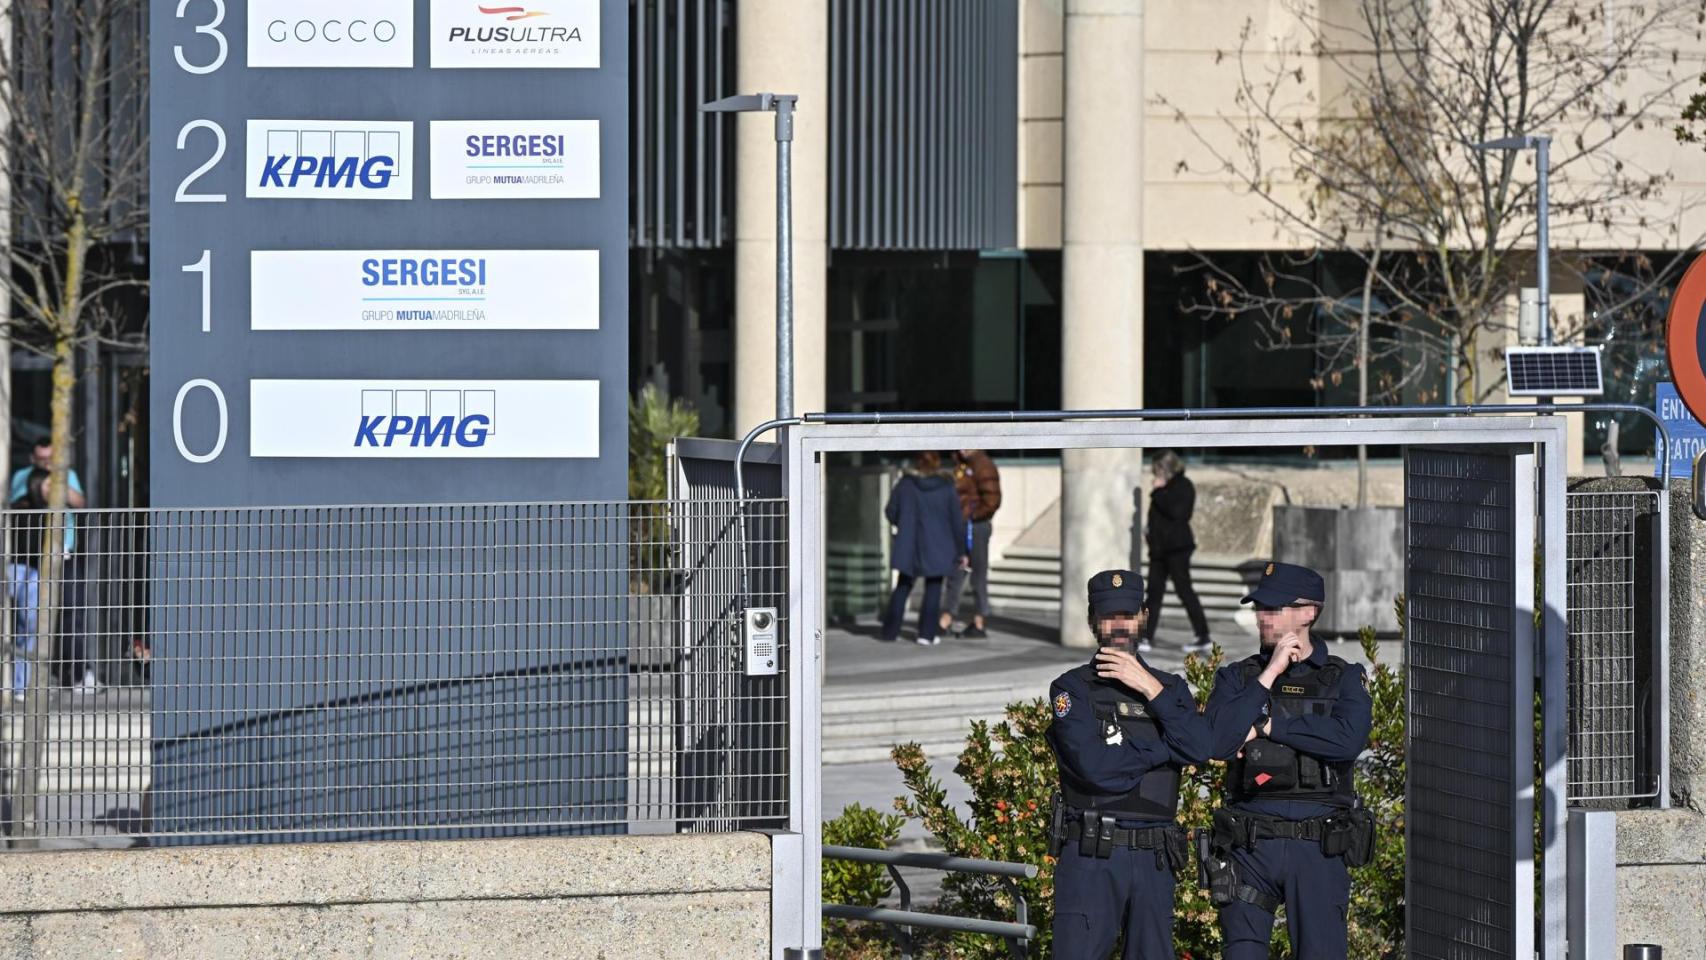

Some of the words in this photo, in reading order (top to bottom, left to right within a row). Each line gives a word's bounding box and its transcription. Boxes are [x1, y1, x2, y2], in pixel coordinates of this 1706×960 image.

[173, 0, 229, 75] 3
[267, 19, 396, 43] GOCCO
[174, 119, 227, 203] 2
[465, 134, 564, 157] SERGESI
[259, 154, 394, 189] KPMG
[465, 175, 492, 185] GRUPO
[361, 258, 486, 286] SERGESI
[181, 249, 211, 333] 1
[361, 310, 394, 321] GRUPO
[172, 378, 229, 464] 0
[354, 414, 490, 448] KPMG
